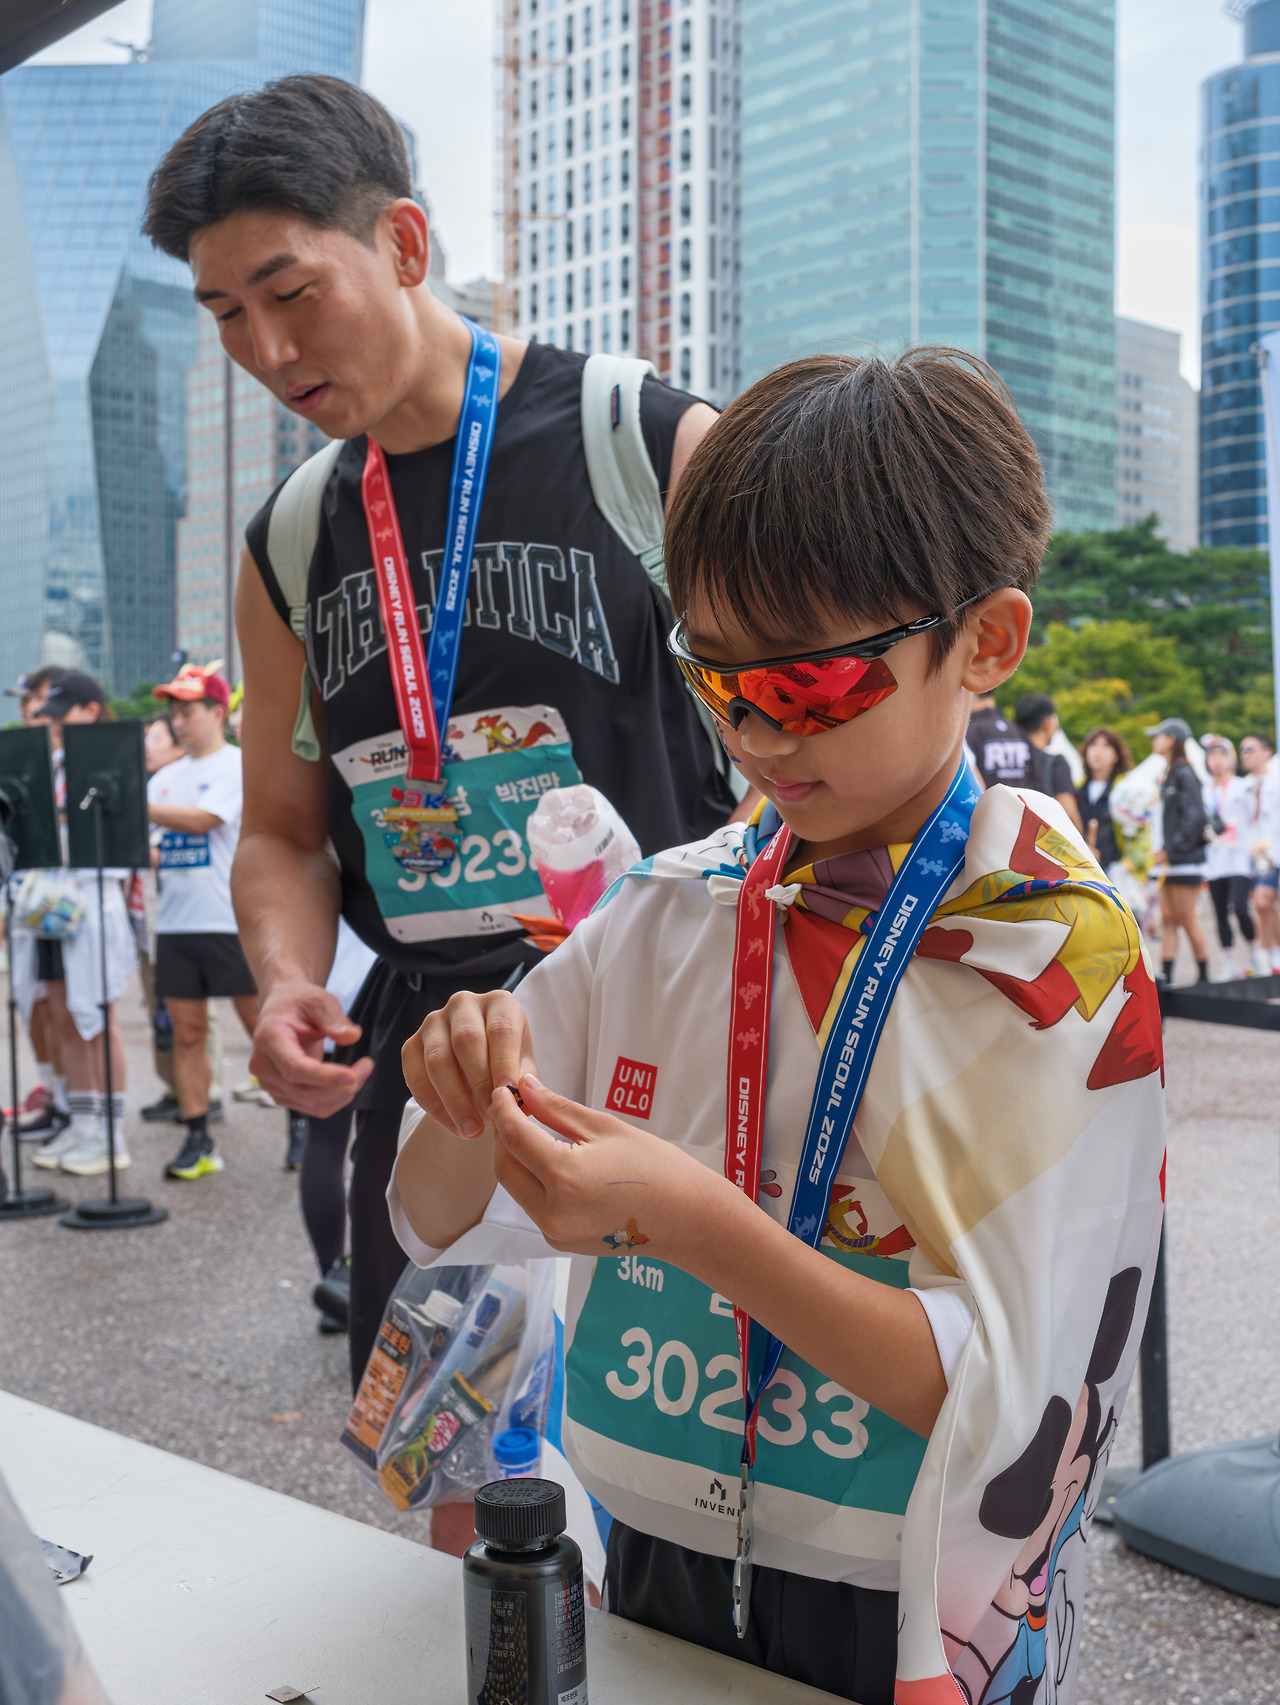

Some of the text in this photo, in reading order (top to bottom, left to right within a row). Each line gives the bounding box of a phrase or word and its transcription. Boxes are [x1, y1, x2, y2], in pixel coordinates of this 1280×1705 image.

[445, 421, 483, 612] DISNEY RUN SEOUL 2025
[383, 556, 427, 739] DISNEY RUN SEOUL 2025
[370, 745, 405, 767] RUN
[618, 1064, 652, 1090] UNI
[808, 893, 919, 1186] DISNEY RUN SEOUL 2025
[613, 1086, 649, 1112] QLO
[736, 1077, 750, 1167] DISNEY
[617, 1255, 665, 1293] 3km
[605, 1326, 871, 1460] 30233
